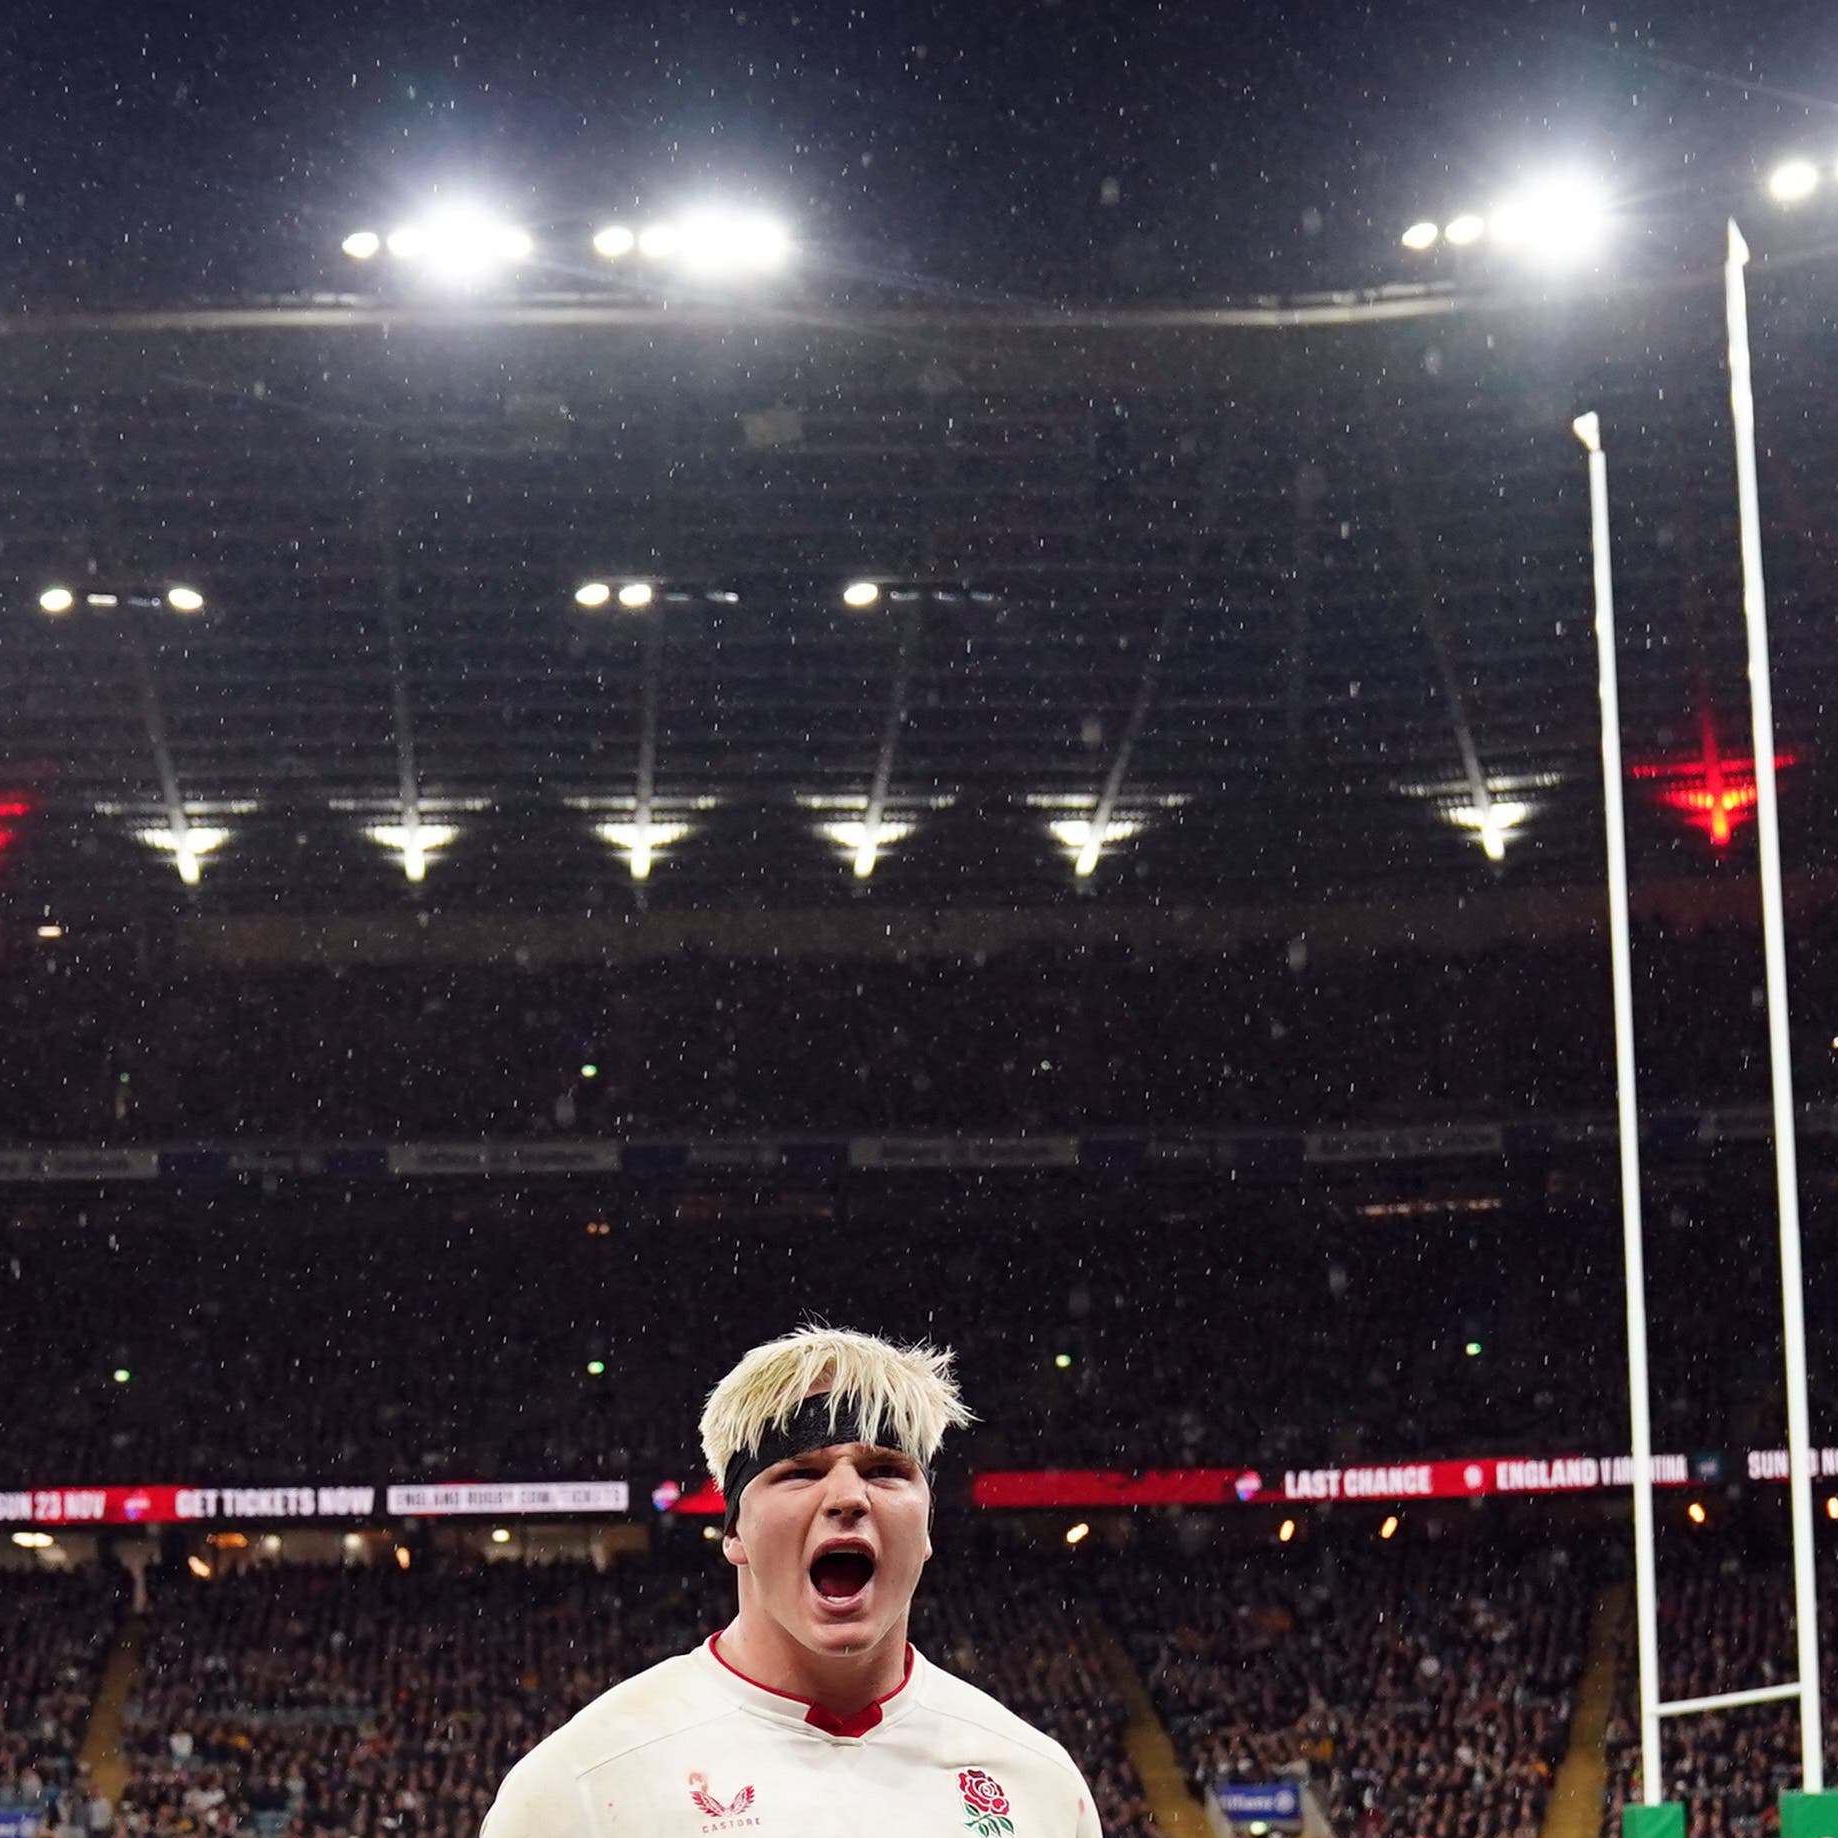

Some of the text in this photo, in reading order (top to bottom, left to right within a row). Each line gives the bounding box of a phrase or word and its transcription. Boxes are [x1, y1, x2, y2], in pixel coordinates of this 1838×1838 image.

[1496, 1458, 1599, 1491] ENGLAND
[1747, 1449, 1789, 1480] SUN
[1284, 1464, 1432, 1499] LAST CHANCE
[175, 1486, 374, 1518] GET TICKETS NOW
[701, 1817, 762, 1834] CASTORE
